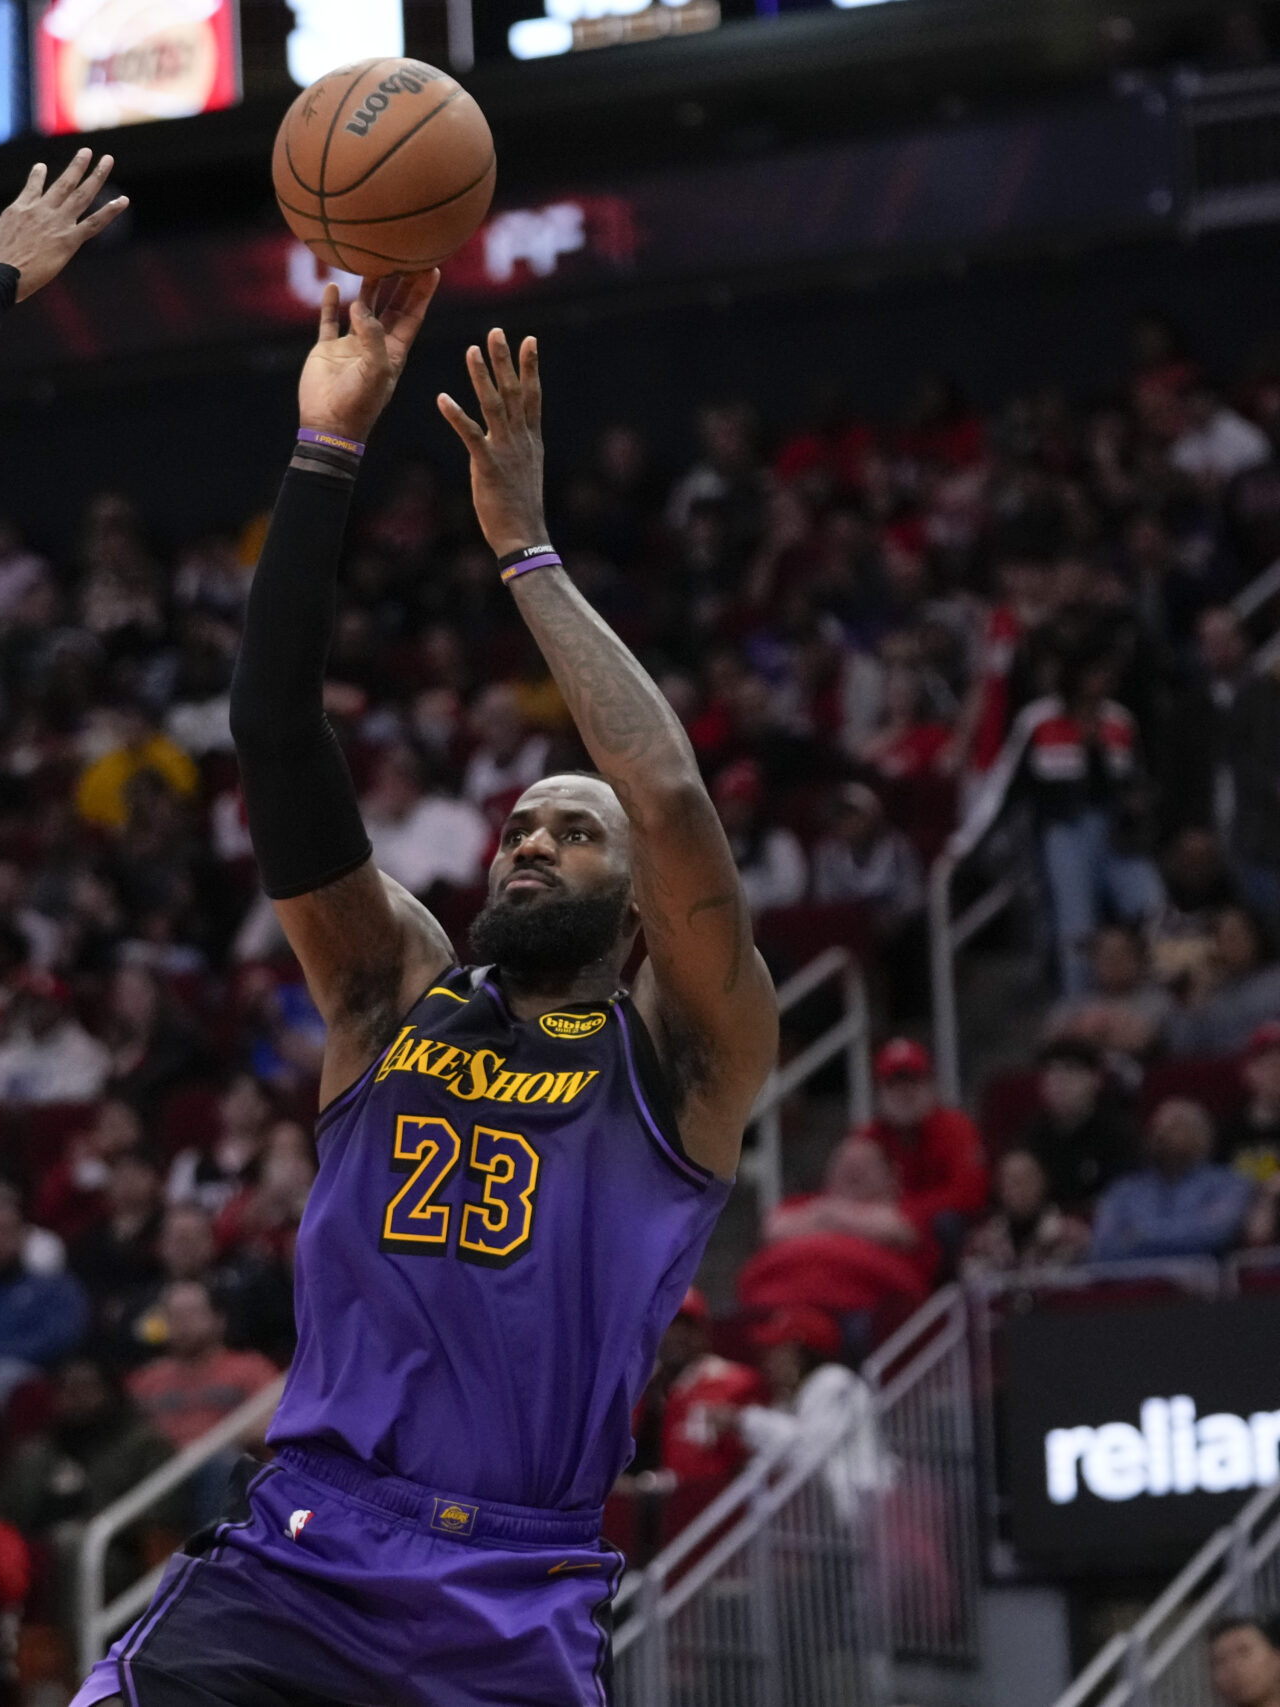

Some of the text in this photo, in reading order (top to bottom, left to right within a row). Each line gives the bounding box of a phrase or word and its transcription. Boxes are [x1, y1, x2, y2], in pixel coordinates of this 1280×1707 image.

[320, 435, 357, 451] PROMISE
[546, 1017, 603, 1031] bibigo
[380, 1113, 541, 1264] 23
